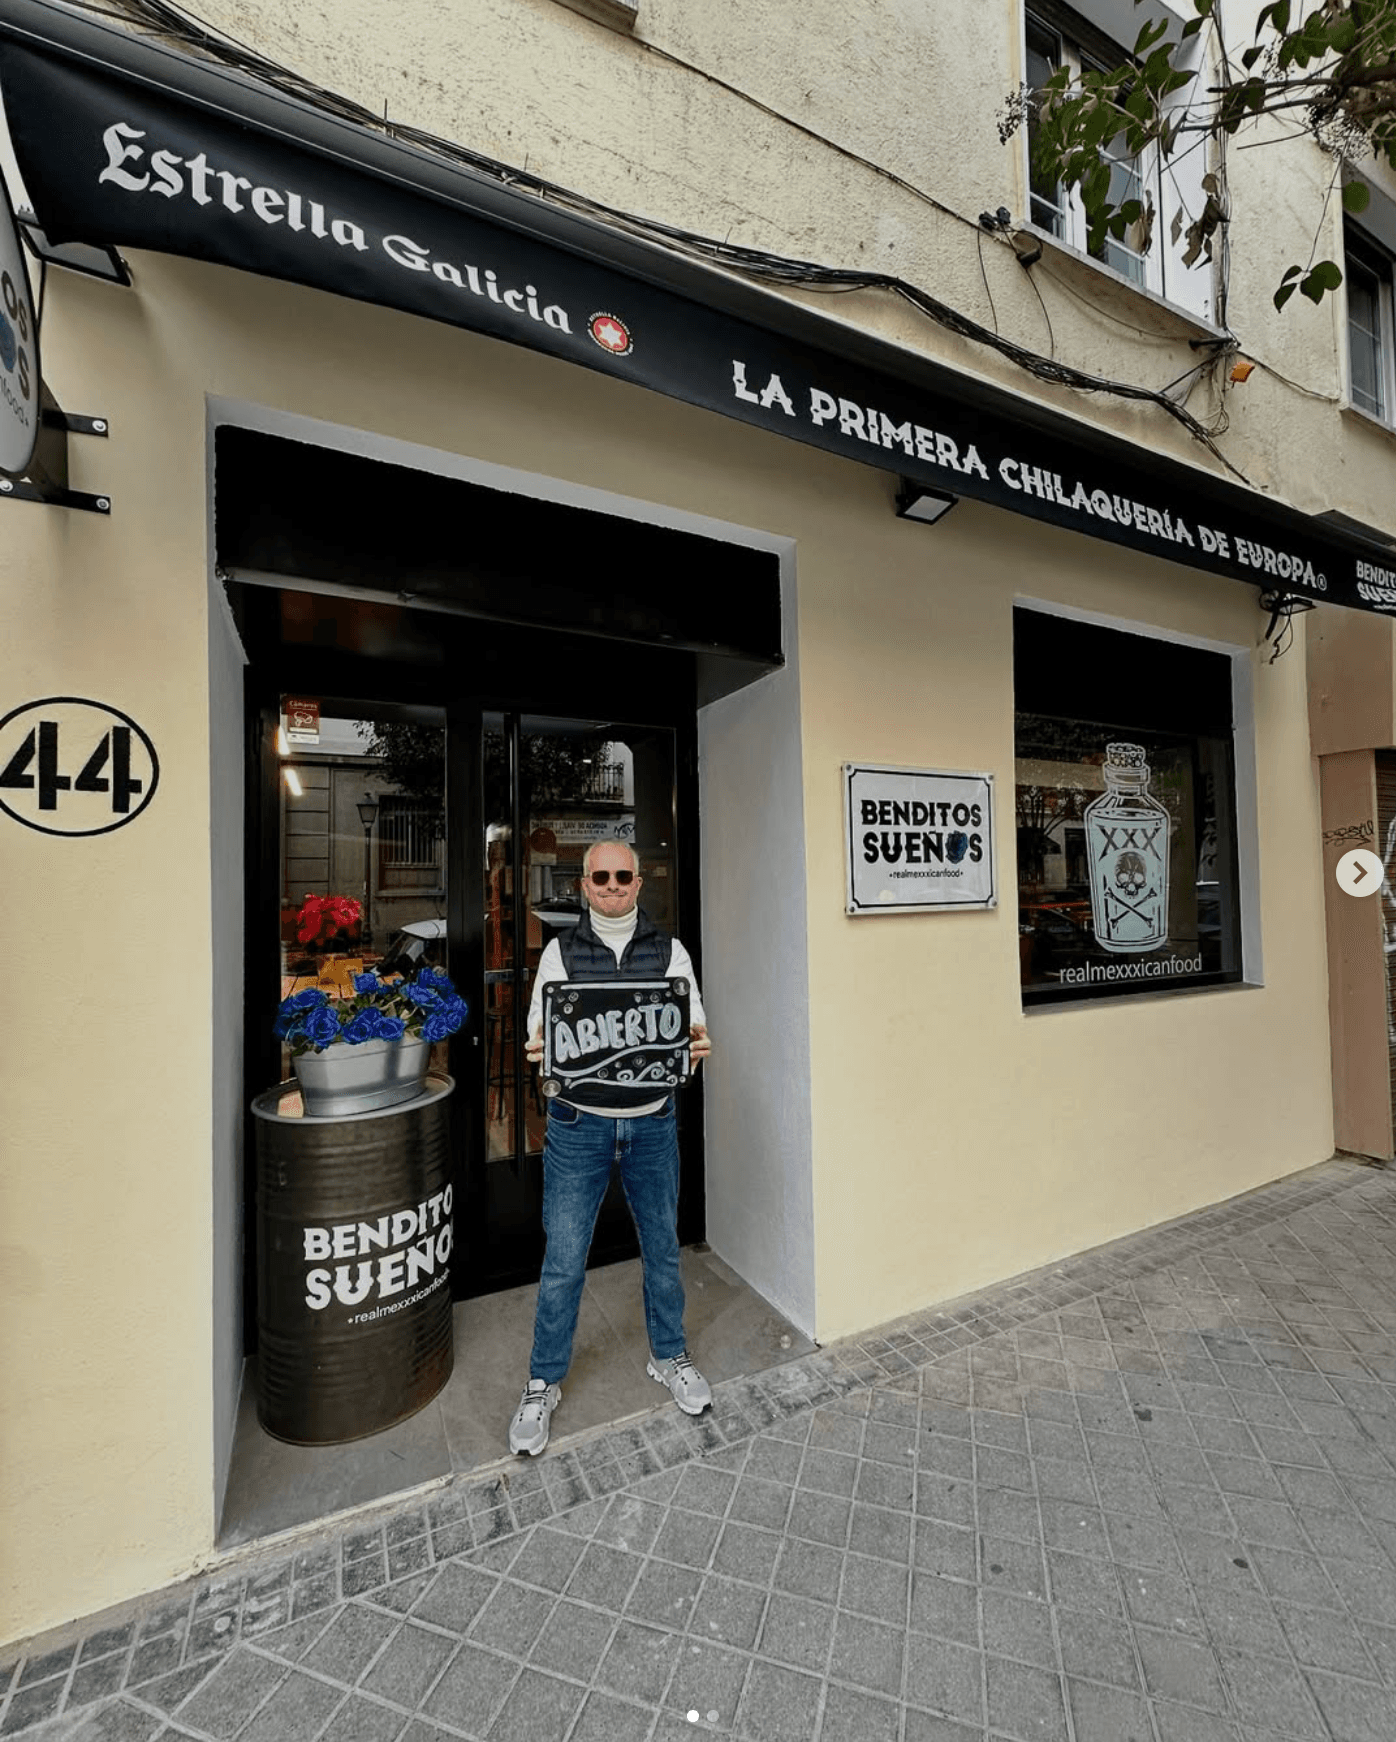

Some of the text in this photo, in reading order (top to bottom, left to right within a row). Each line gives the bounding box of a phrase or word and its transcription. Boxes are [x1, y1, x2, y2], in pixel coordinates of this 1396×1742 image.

[98, 122, 369, 251] Estrella
[382, 235, 574, 335] Galicia
[732, 359, 796, 417] LA
[809, 387, 990, 481] PRIMERA
[998, 457, 1195, 547] CHILAQUERÍA
[1197, 524, 1231, 559] DE
[1356, 560, 1396, 589] BENDIT
[0, 721, 142, 813] 44
[860, 799, 983, 827] BENDITOS
[862, 830, 983, 864] SUEÑS
[1095, 824, 1162, 861] XXX
[1060, 951, 1203, 984] realmexxxicanfood
[555, 1002, 682, 1064] ABIERTO
[305, 1222, 454, 1311] SUEÑO
